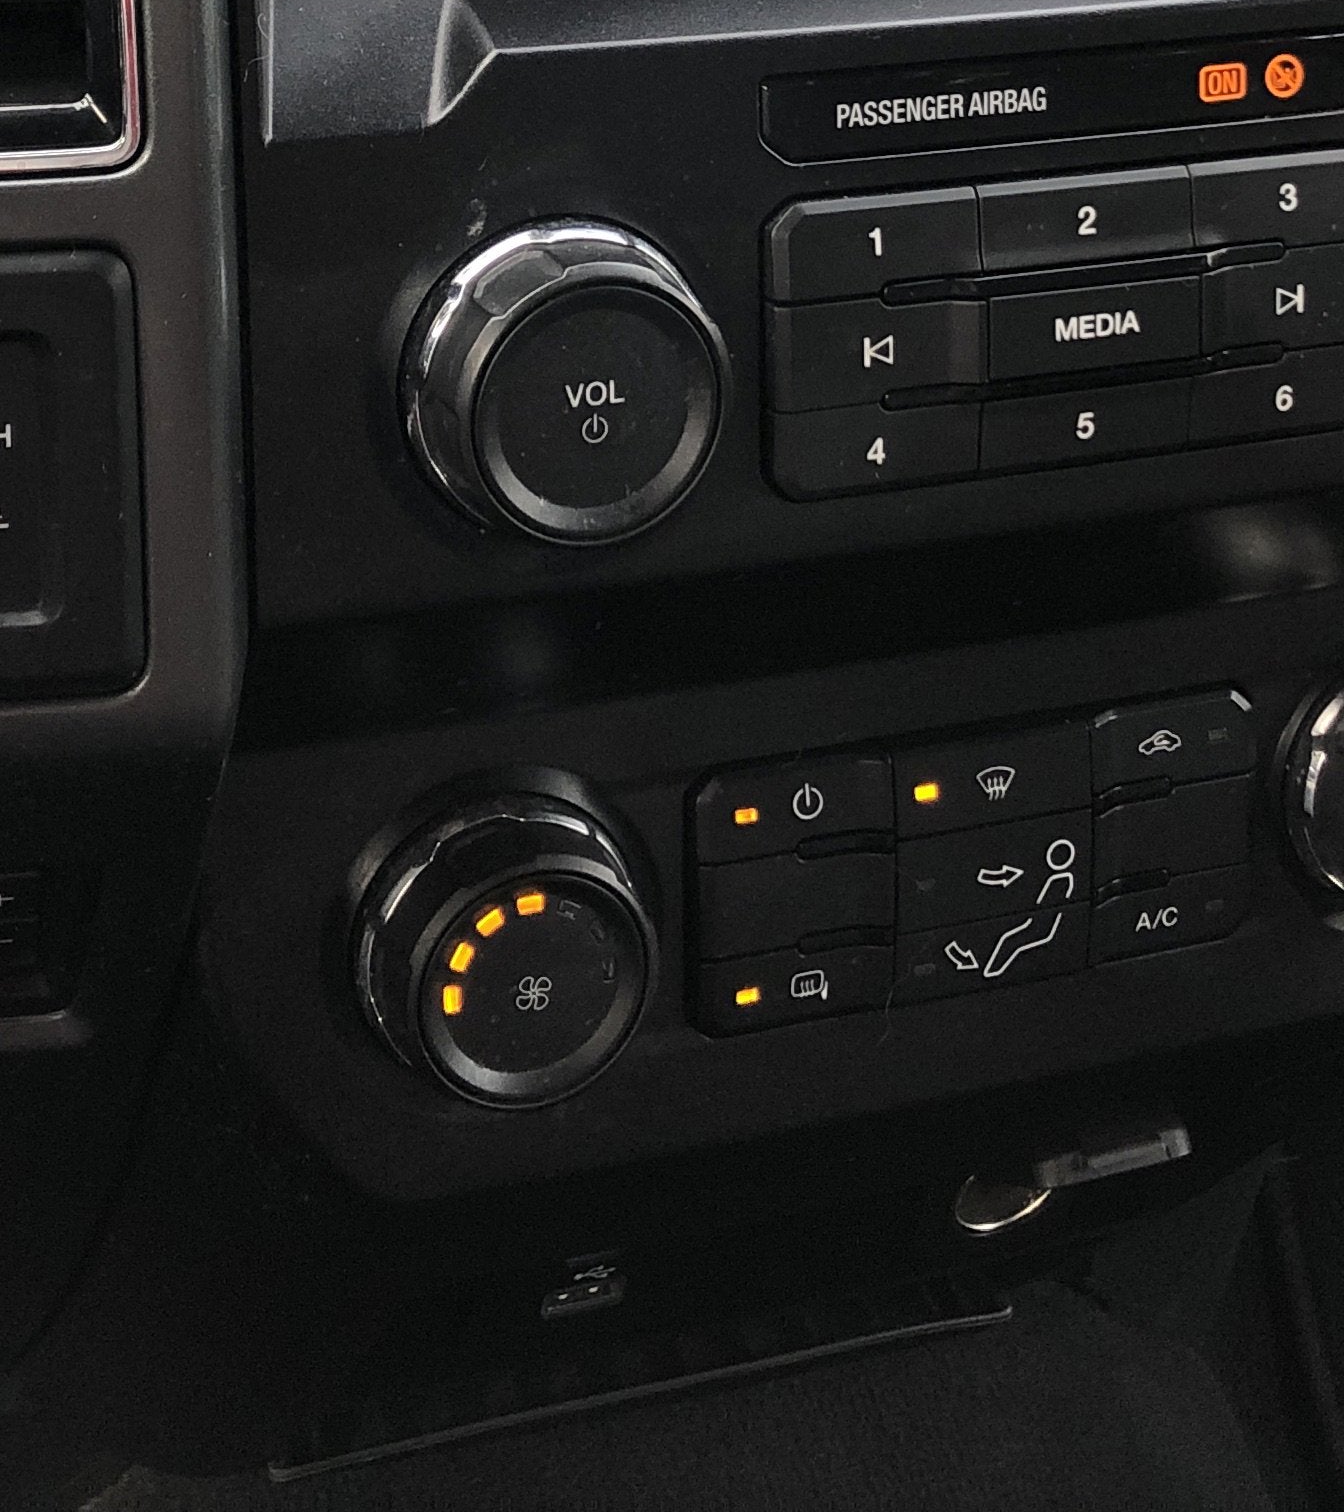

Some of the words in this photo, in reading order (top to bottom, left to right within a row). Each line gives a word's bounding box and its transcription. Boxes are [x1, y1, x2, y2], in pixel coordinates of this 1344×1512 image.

[1208, 70, 1237, 95] ON
[836, 93, 965, 129] PASSENGER
[967, 86, 1047, 117] AIRBAG
[1278, 182, 1299, 212] 3
[1077, 205, 1097, 236] 2
[868, 227, 883, 257] 1
[1054, 309, 1141, 342] MEDIA
[565, 379, 626, 408] VOL
[1275, 384, 1294, 412] 6
[1075, 411, 1095, 440] 5
[866, 437, 886, 465] 4
[1135, 906, 1179, 932] A/C
